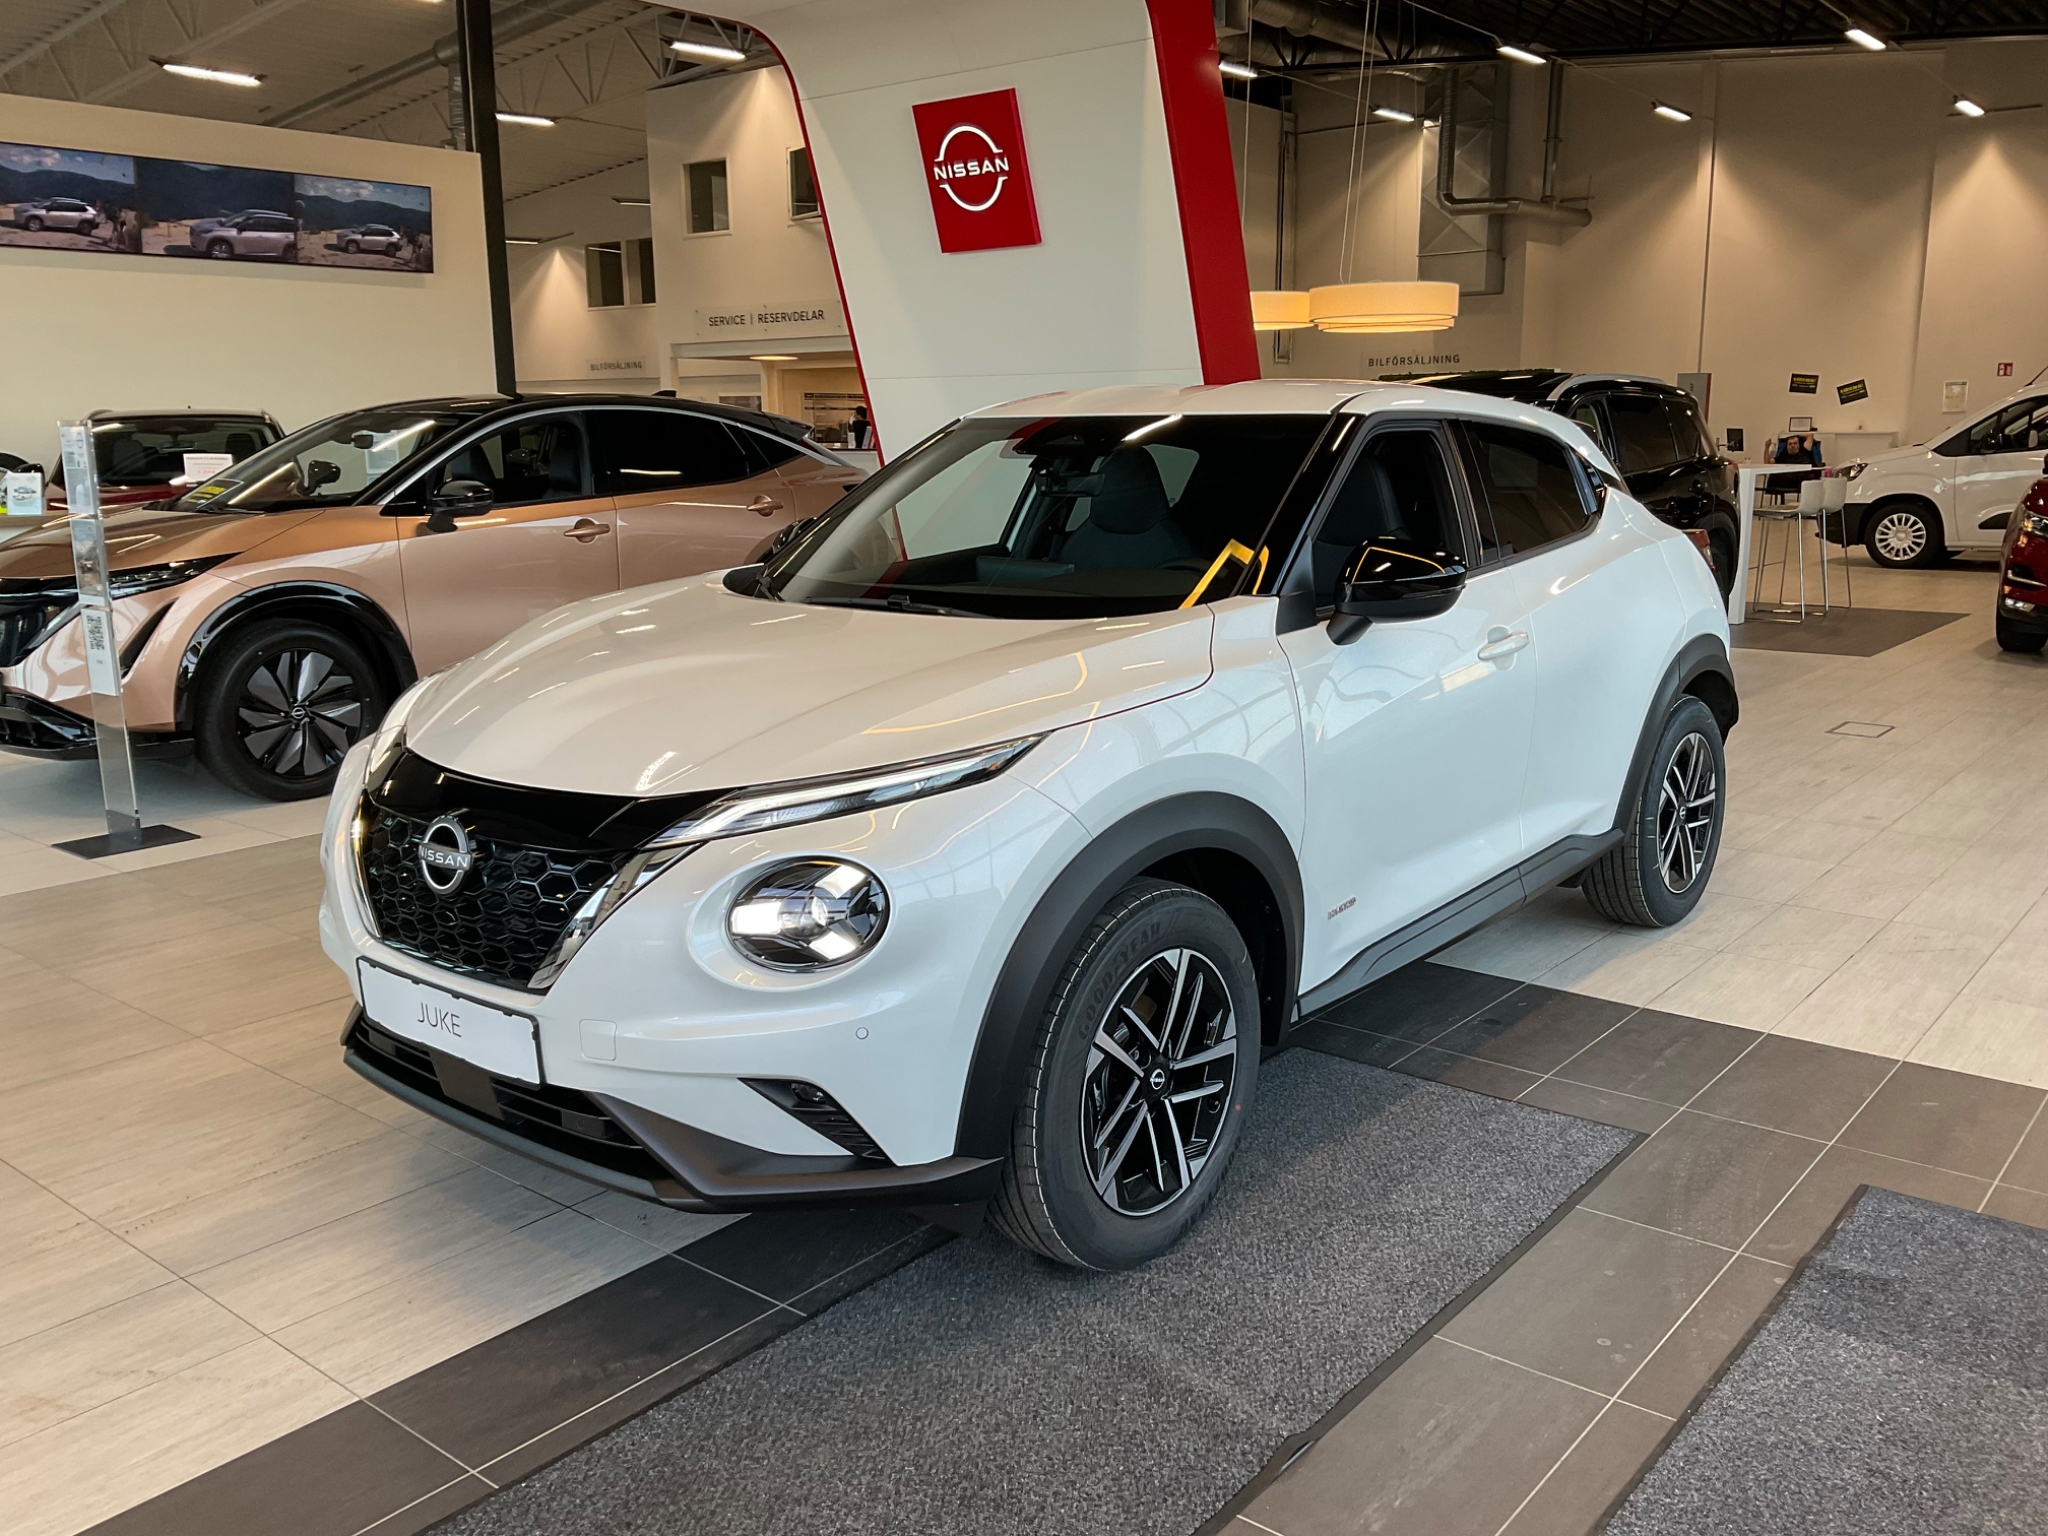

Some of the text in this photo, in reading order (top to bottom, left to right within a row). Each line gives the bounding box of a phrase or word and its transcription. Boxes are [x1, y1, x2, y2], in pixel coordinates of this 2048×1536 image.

[933, 155, 1010, 181] NISSAN
[708, 309, 825, 327] SERVICE RESERVDELAR
[1368, 353, 1461, 367] BILFÖRSÄLJNING
[418, 844, 469, 868] NISSAN
[417, 1002, 462, 1038] JUKE
